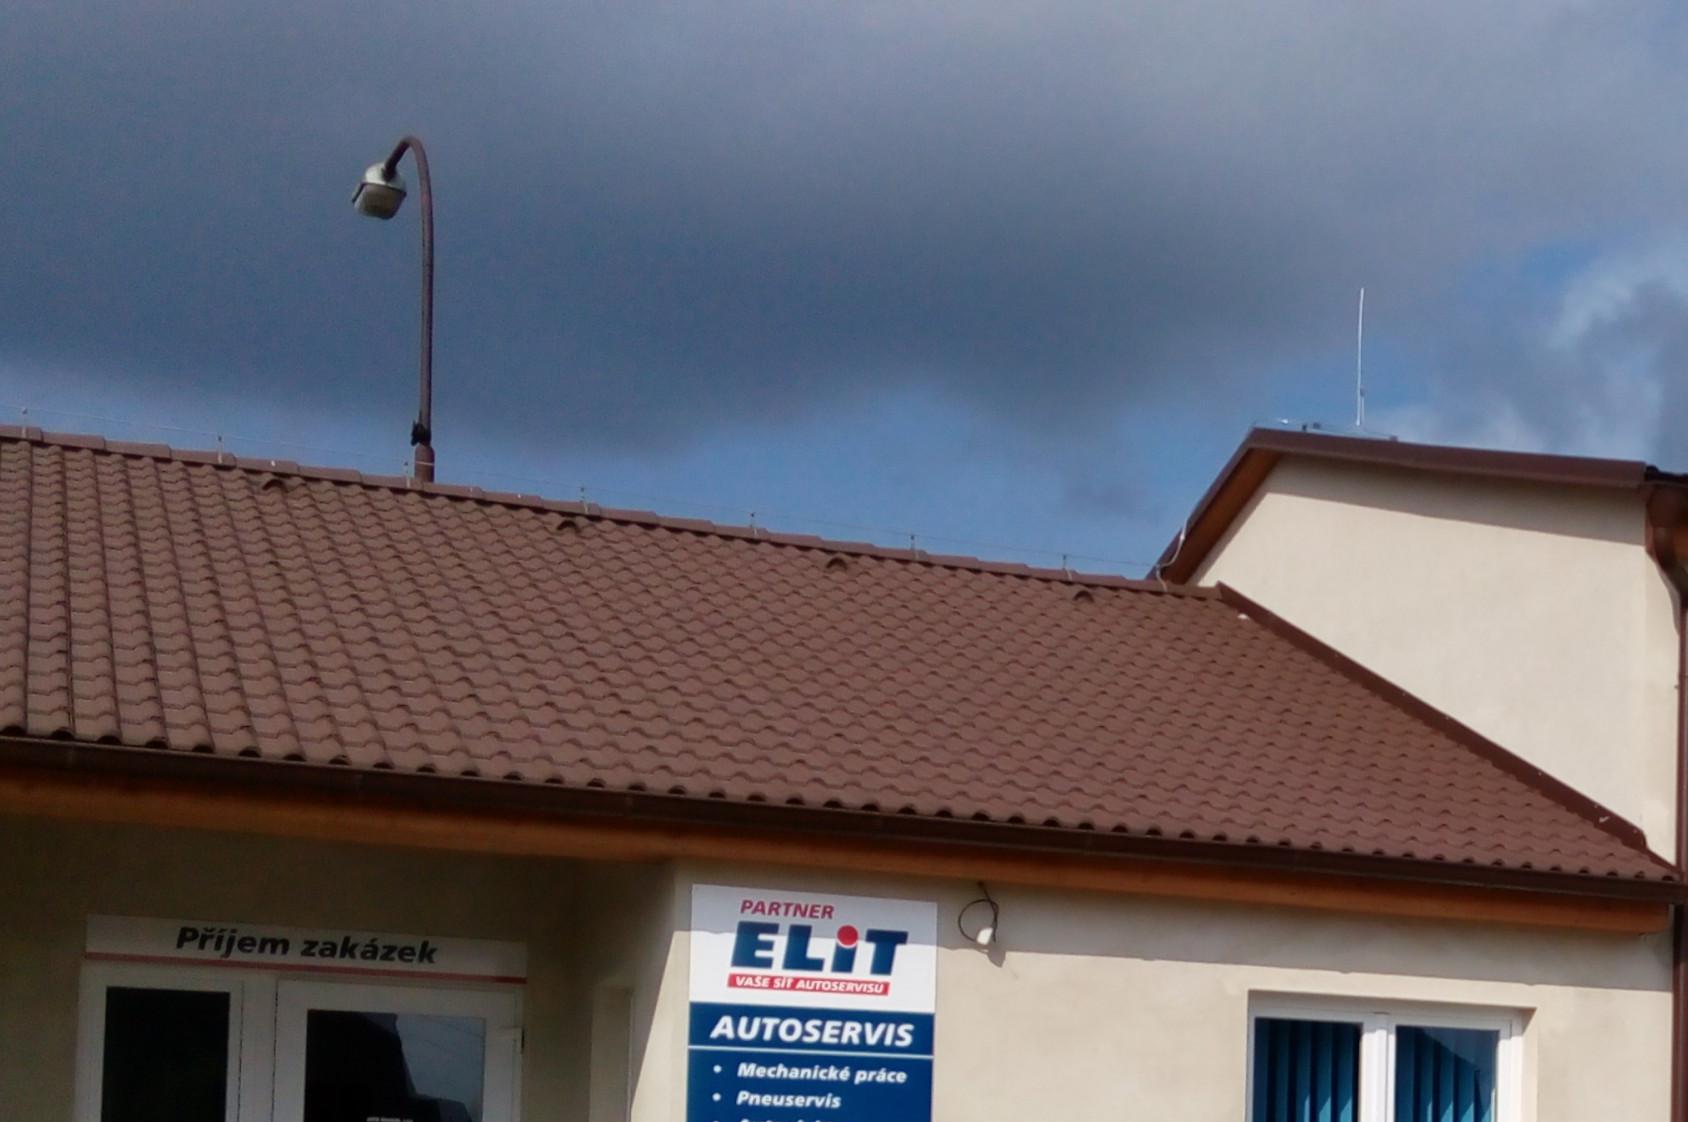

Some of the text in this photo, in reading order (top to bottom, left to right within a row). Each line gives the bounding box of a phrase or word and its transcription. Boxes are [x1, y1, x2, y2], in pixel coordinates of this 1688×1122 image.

[740, 899, 835, 919] PARTNER
[175, 925, 438, 965] Příjem zakázek
[735, 974, 770, 989] VAŠE
[710, 1015, 915, 1047] AUTOSERVIS
[737, 1062, 908, 1085] Mechanické práce
[736, 1090, 842, 1109] Pneuservis
